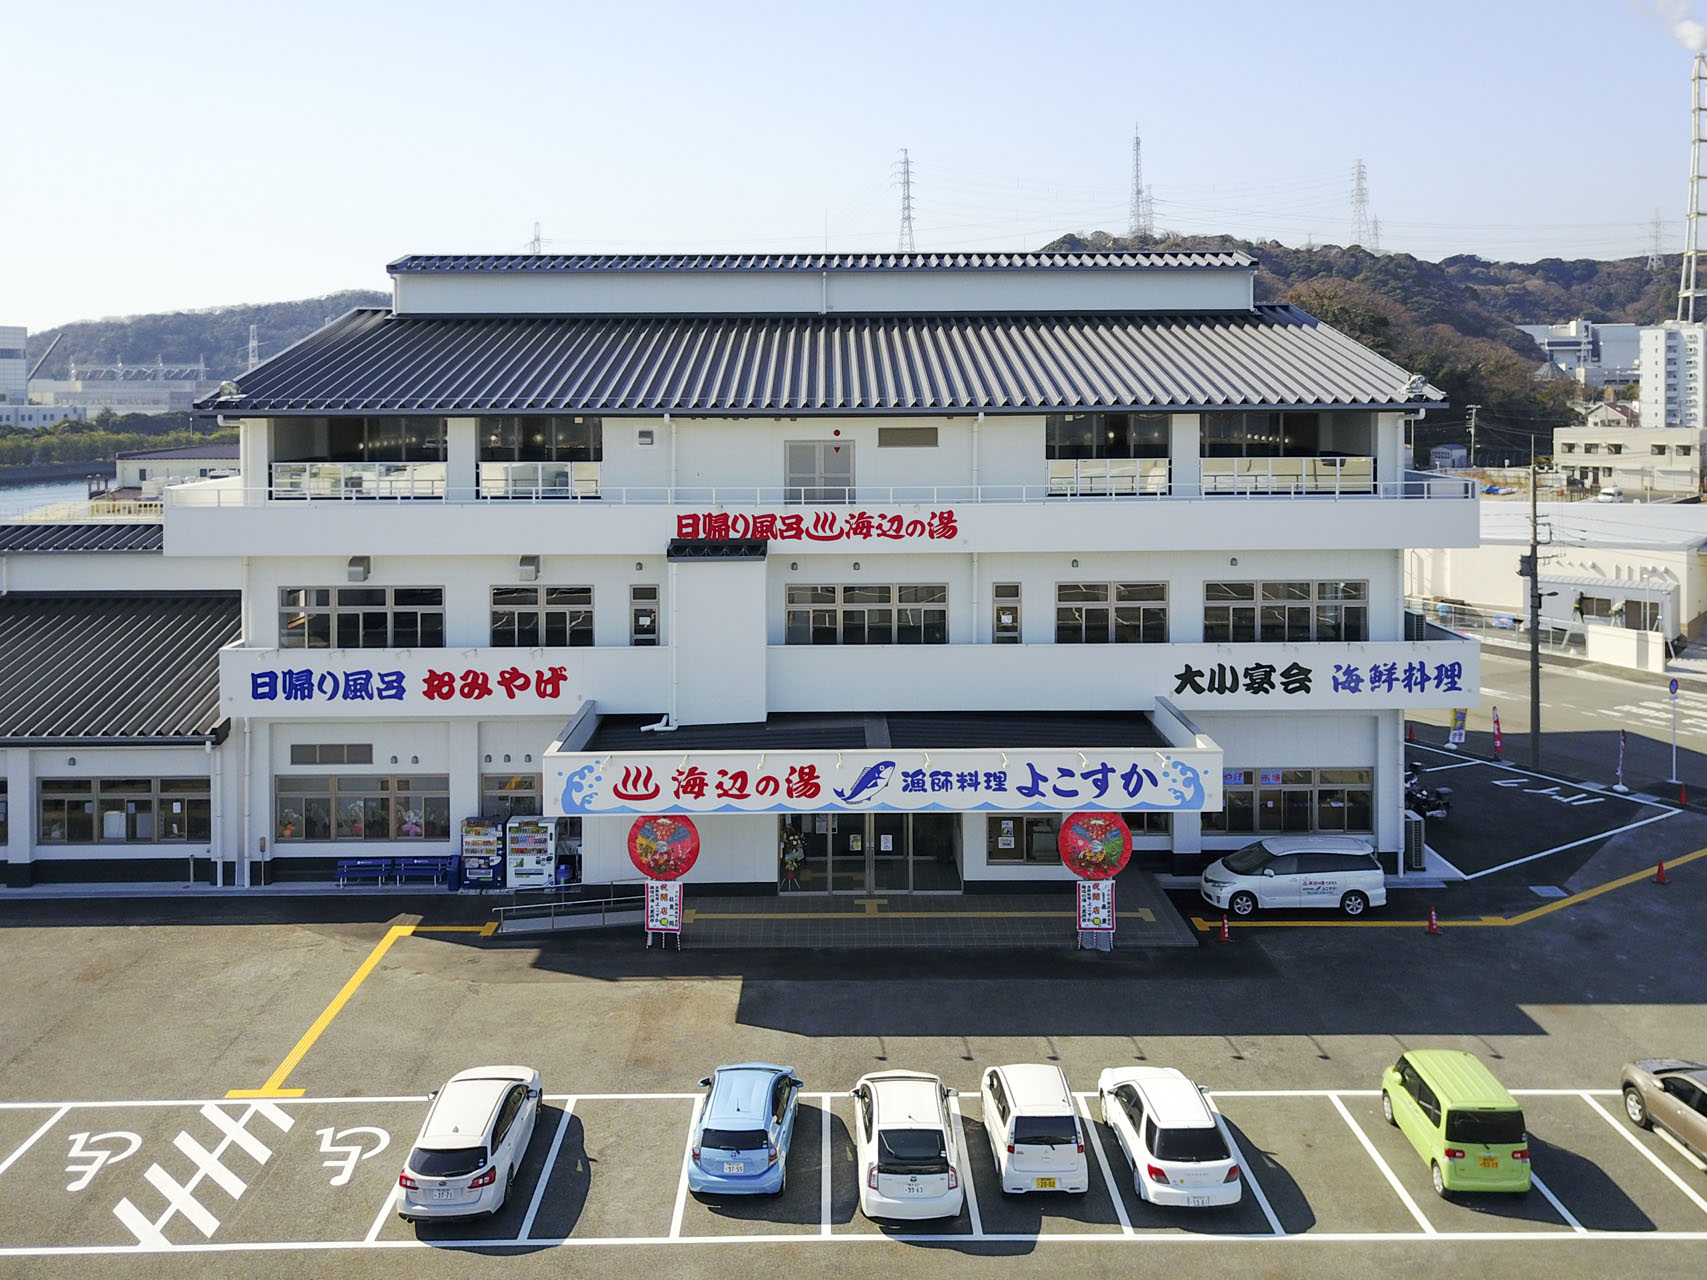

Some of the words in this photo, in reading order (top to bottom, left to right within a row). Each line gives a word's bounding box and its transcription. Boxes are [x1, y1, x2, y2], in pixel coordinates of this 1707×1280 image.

[677, 513, 804, 541] 日帰り風呂
[845, 510, 959, 540] 海辺の湯
[251, 669, 406, 701] 日帰り風呂
[422, 667, 568, 700] おみやげ
[1174, 662, 1312, 695] 大小宴会
[1332, 661, 1463, 694] 海鮮料理
[672, 765, 821, 799] 海辺の湯
[902, 769, 1007, 793] 漁師料理
[1016, 762, 1158, 799] よこすか
